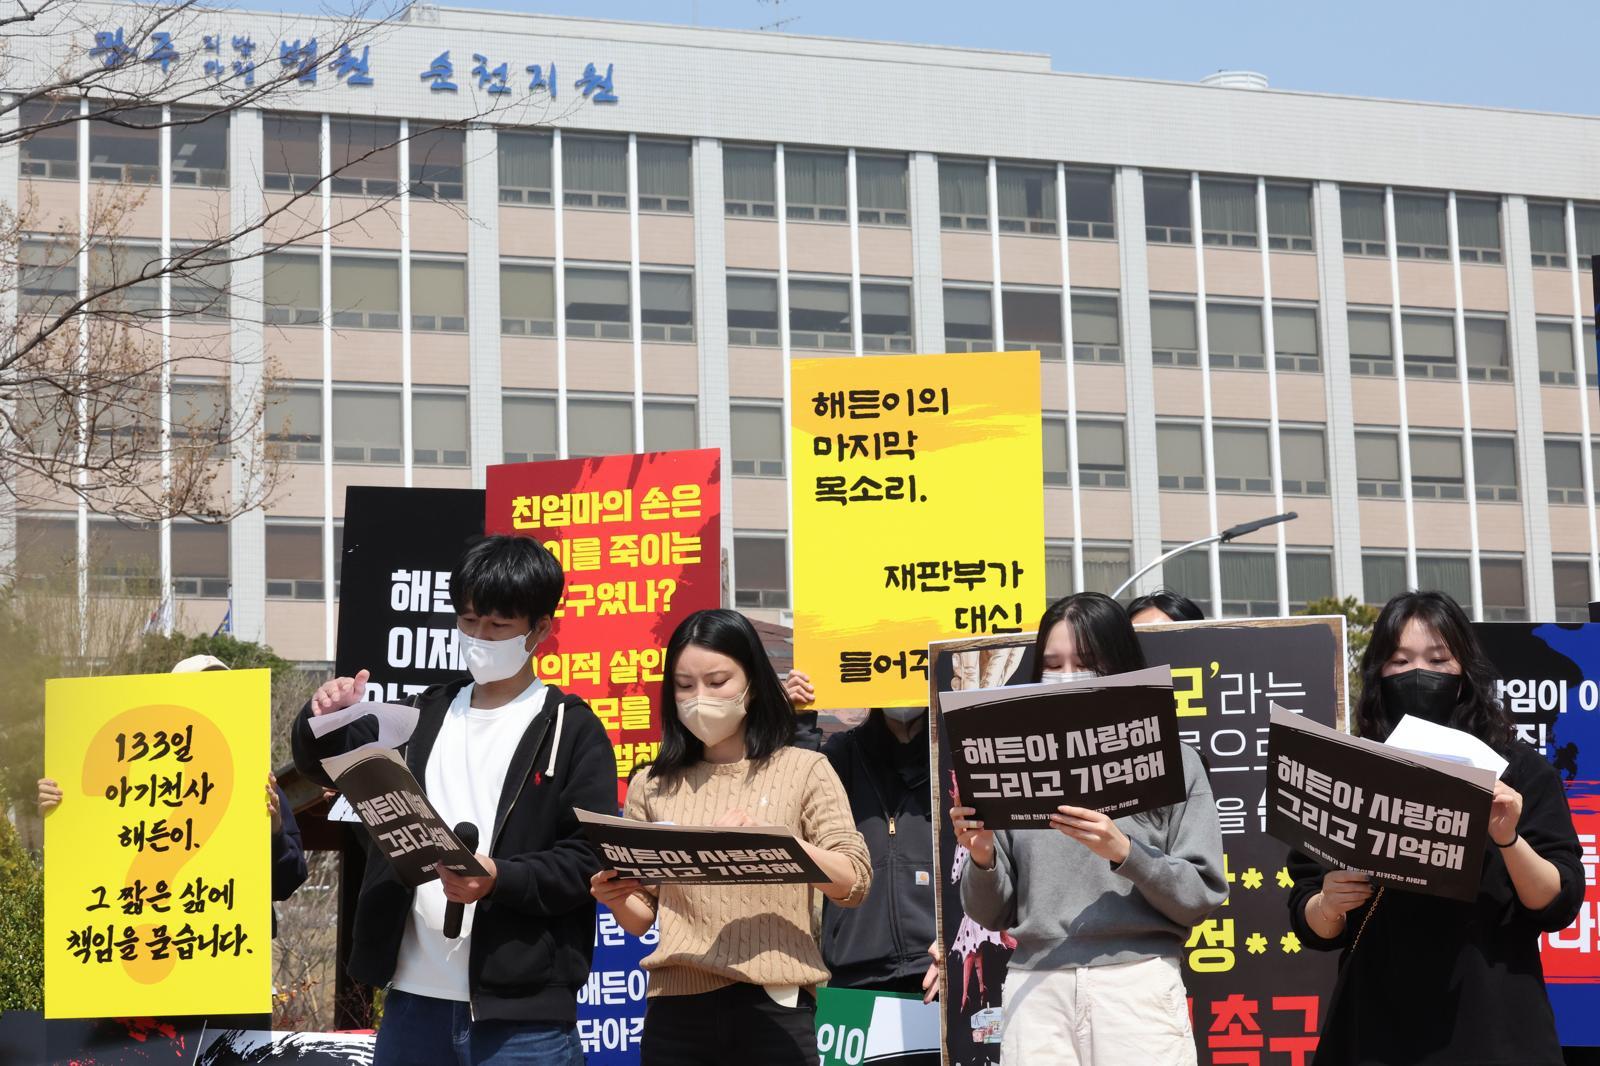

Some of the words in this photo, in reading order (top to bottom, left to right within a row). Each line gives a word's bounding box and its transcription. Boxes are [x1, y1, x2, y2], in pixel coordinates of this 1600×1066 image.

[420, 50, 619, 103] 순천지원
[812, 388, 949, 419] 해든이의
[814, 431, 918, 462] 마지막
[511, 488, 632, 530] 친엄마의
[640, 484, 702, 521] 손은
[815, 475, 927, 506] 목소리.
[543, 537, 602, 572] 이를
[609, 531, 702, 568] 죽이는
[884, 560, 1024, 592] 재판부가
[554, 578, 677, 618] 구였나?
[955, 603, 1023, 634] 대신
[387, 626, 469, 671] 이제
[532, 650, 601, 687] 의적
[586, 695, 651, 730] 모를
[115, 725, 194, 763] 133일
[961, 733, 1059, 765] 해든아
[1066, 716, 1162, 758] 사랑해
[105, 771, 215, 808] 아기천사
[970, 770, 1065, 798] 그리고
[1070, 750, 1166, 794] 기억해
[357, 791, 412, 827] 해든아
[1277, 755, 1365, 815] 해든아
[1368, 793, 1470, 838] 사랑해
[118, 817, 200, 853] 해든이.
[378, 822, 434, 858] 그리고
[1277, 787, 1358, 850] 그리고
[1367, 828, 1465, 871] 기억해
[600, 842, 694, 865] 해든아
[696, 847, 793, 864] 사랑해
[613, 865, 706, 880] 그리고
[708, 861, 805, 877] 기억해
[86, 885, 111, 912] 그
[117, 879, 171, 915] 짧은
[179, 877, 234, 914] 삶에
[66, 924, 139, 964] 책임을
[145, 923, 253, 961] 묻습니다.
